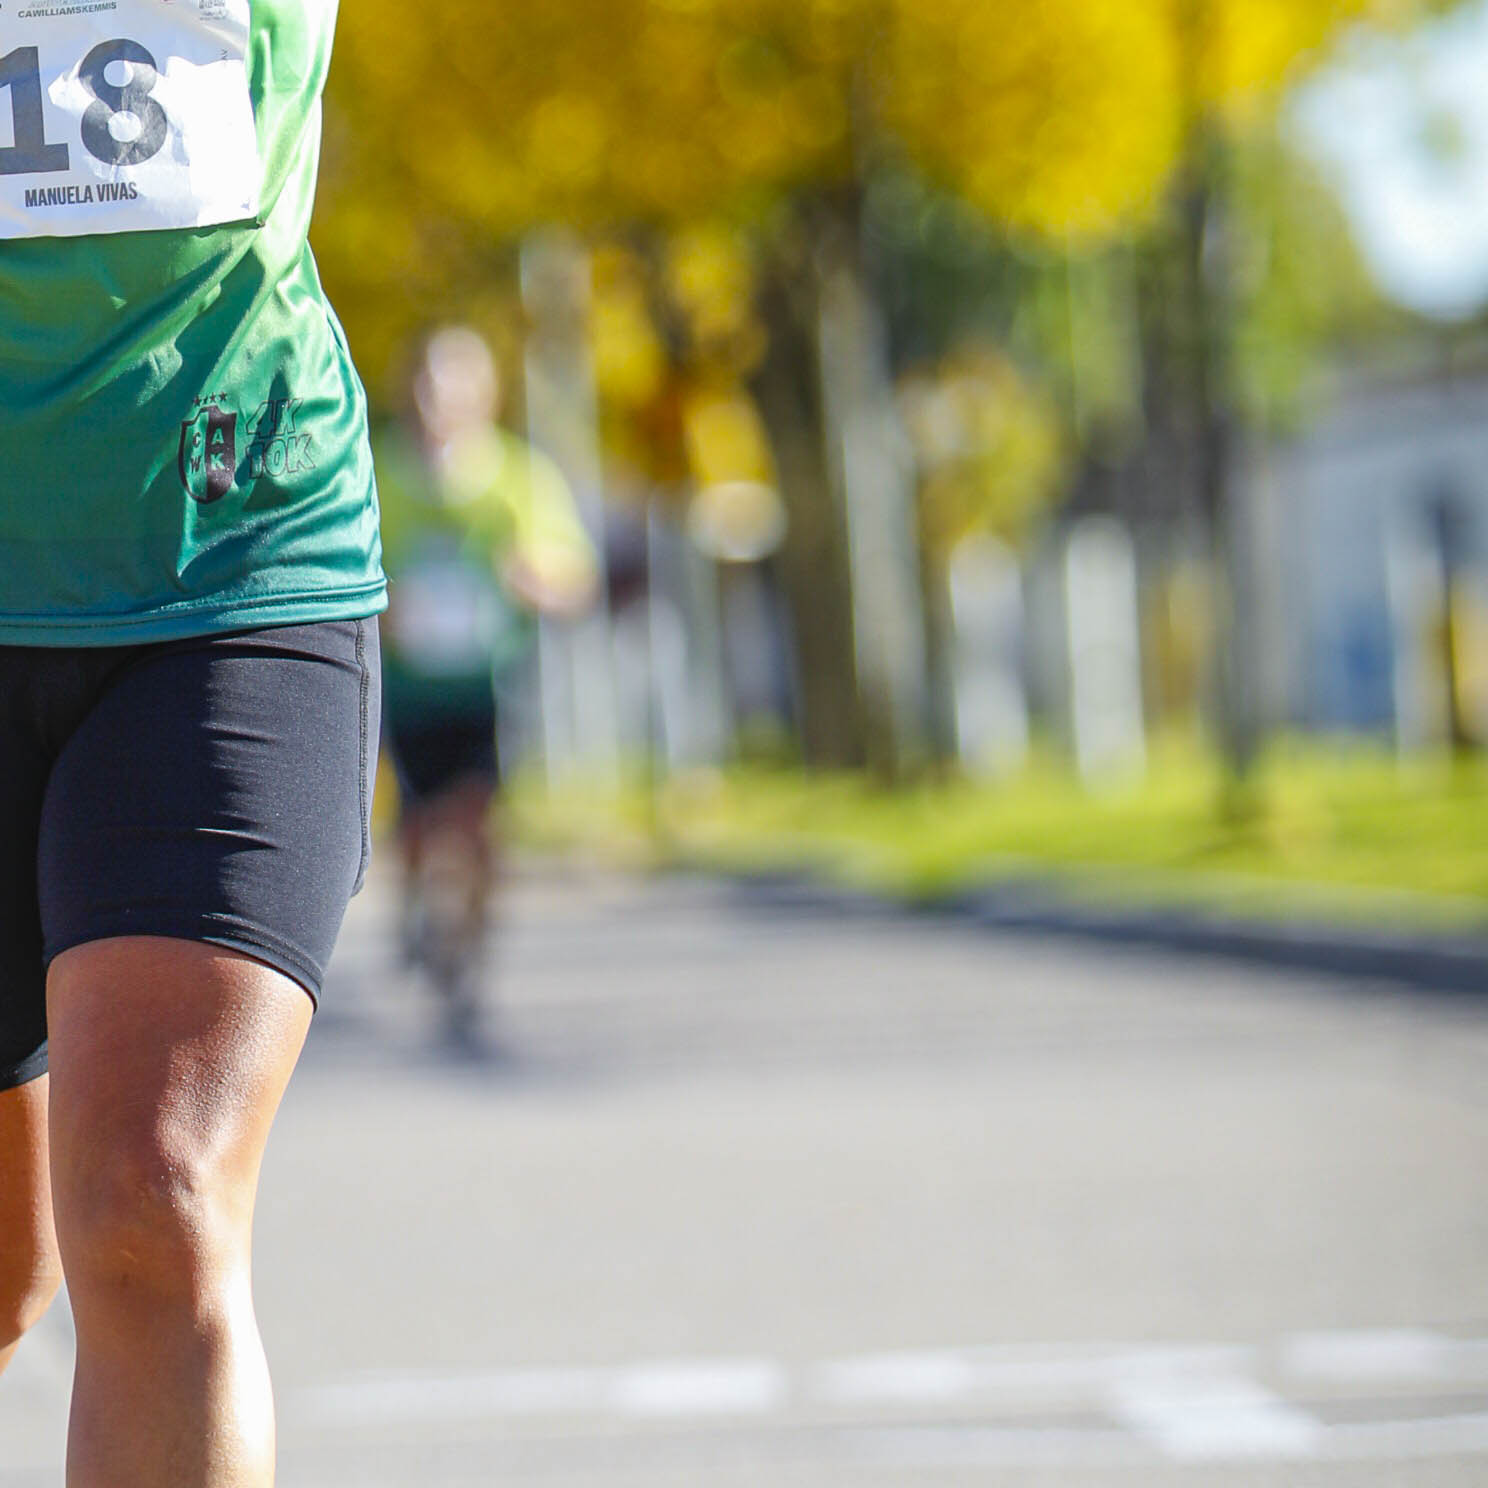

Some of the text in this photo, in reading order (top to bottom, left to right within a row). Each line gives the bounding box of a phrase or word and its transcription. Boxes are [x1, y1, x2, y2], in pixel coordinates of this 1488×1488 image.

[24, 182, 138, 207] MANUELA VIVAS
[245, 398, 304, 439] 4K
[244, 433, 316, 479] 10K
